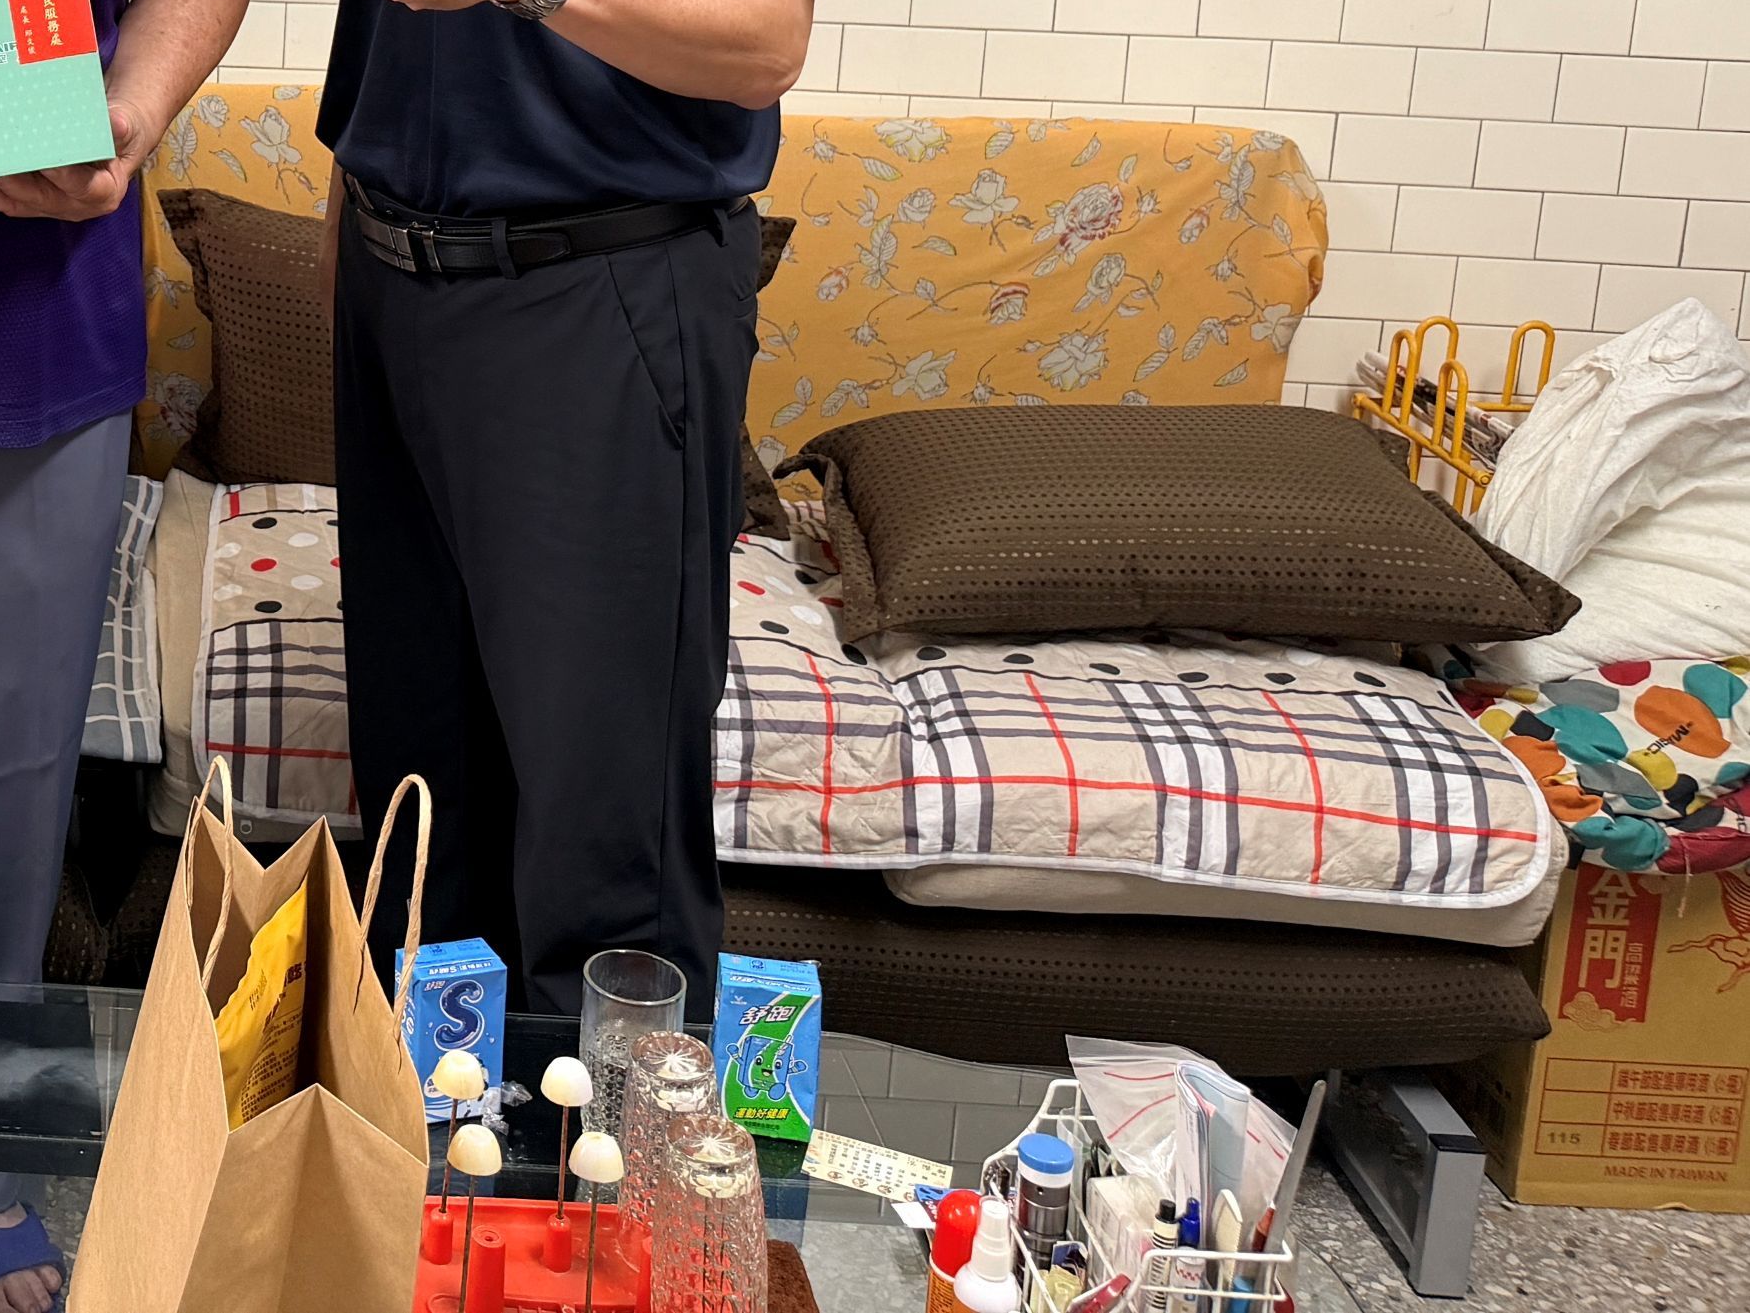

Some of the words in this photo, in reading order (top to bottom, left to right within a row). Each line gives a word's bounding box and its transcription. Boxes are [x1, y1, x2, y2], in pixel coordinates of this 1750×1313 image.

[1578, 869, 1637, 988] 金門
[434, 979, 485, 1052] S
[740, 1005, 797, 1026] 舒跑
[734, 1106, 790, 1121] 運動好健康
[1547, 1131, 1581, 1145] 115
[1604, 1165, 1646, 1179] MADE
[1649, 1167, 1665, 1179] IN
[1669, 1168, 1728, 1183] TAIWAN
